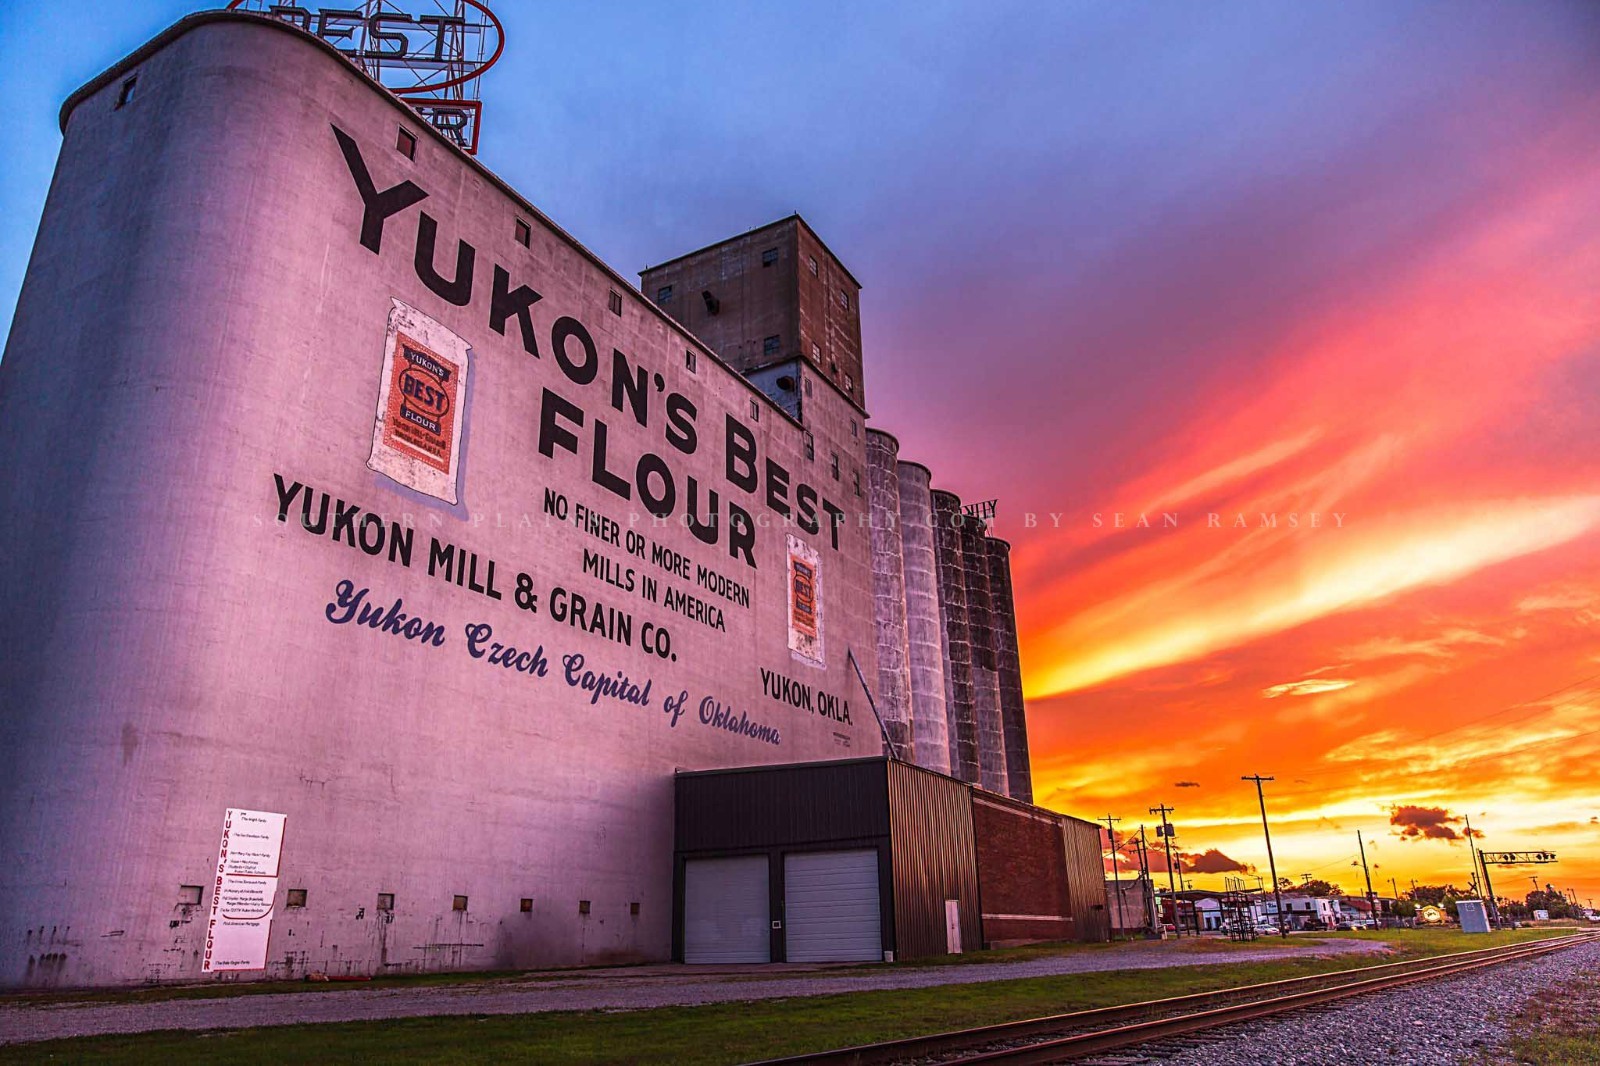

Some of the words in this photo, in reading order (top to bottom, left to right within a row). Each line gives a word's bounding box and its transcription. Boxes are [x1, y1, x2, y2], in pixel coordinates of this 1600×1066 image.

[330, 124, 697, 454] YUKON'S
[725, 413, 846, 551] BEST
[410, 352, 445, 377] YUKON'S
[403, 373, 445, 411] BEST
[405, 411, 436, 431] FLOUR
[538, 387, 757, 569] FLOUR
[273, 473, 414, 568] YUKON
[428, 537, 501, 600] MILL
[515, 572, 538, 613] &
[550, 587, 631, 646] GRAIN
[641, 622, 677, 662] CO.
[544, 487, 568, 520] NO
[575, 503, 620, 547] FINER
[626, 530, 645, 560] OR
[652, 541, 690, 580] MORE
[697, 564, 749, 609] MODERN
[583, 548, 635, 592] MILLS
[642, 574, 657, 603] IN
[664, 586, 725, 632] AMERICA
[326, 579, 445, 647] Yukon
[465, 623, 548, 677] Czech
[562, 654, 652, 706] Capital
[663, 690, 688, 727] of
[699, 696, 781, 745] Oklahoma
[760, 667, 814, 714] YUKON,
[817, 691, 853, 726] OKLA.
[212, 876, 223, 915] BEST
[203, 920, 216, 970] FLOUR
